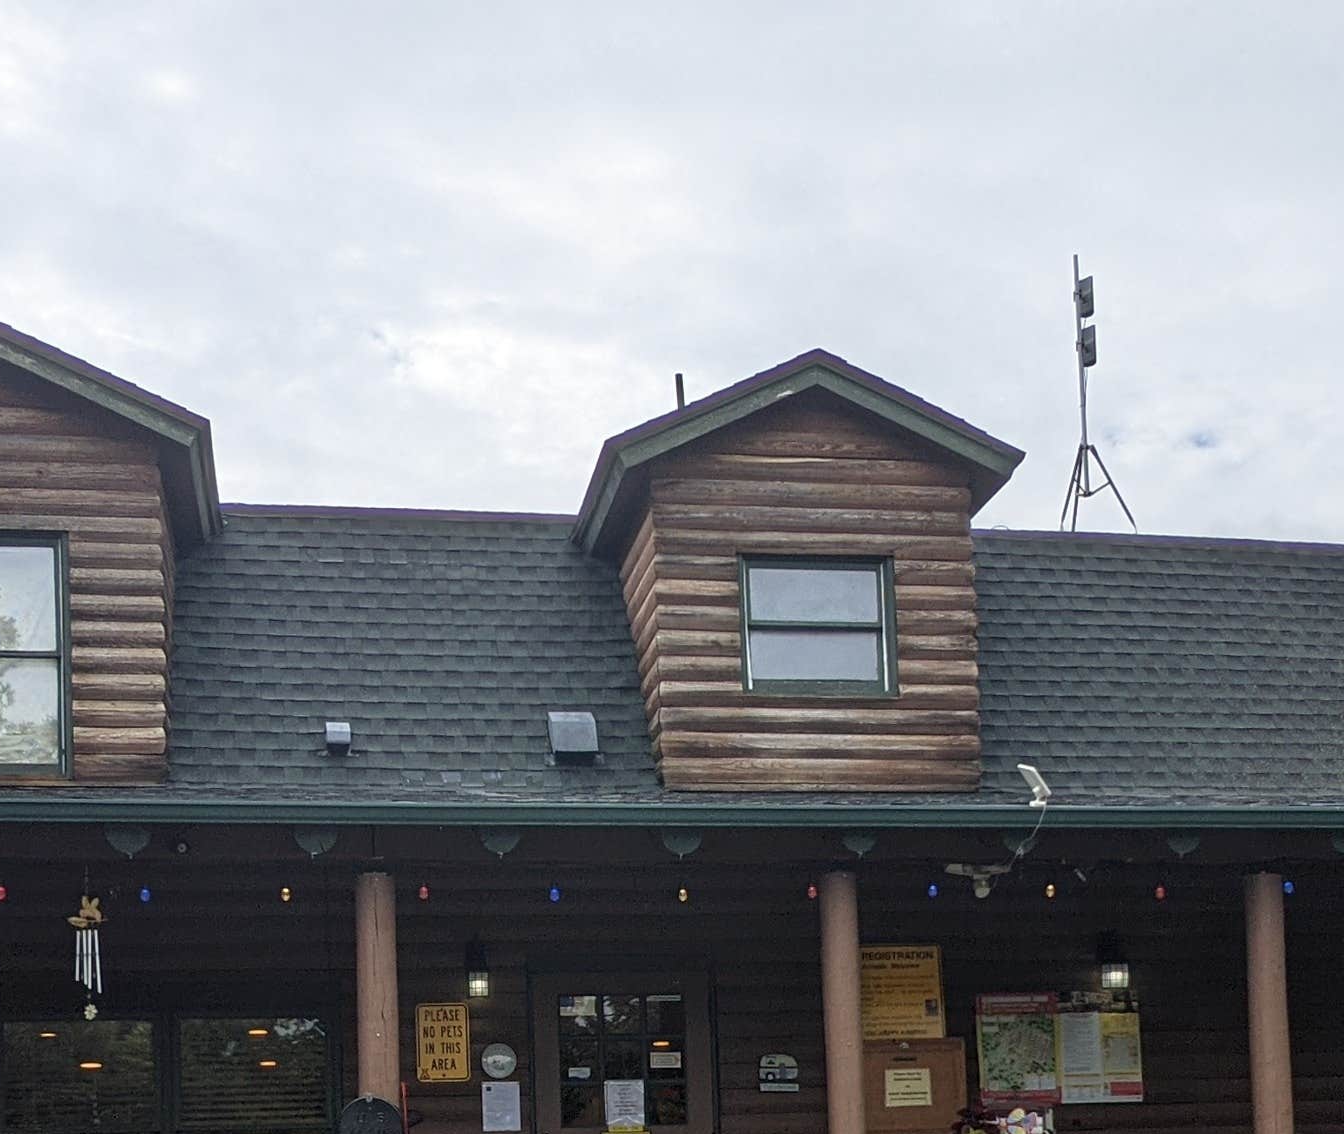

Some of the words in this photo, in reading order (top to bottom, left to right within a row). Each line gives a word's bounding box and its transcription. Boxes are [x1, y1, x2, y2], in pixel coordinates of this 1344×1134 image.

[861, 951, 935, 961] REGISTRATION
[424, 1009, 460, 1021] PLEASE
[423, 1026, 435, 1038] NO
[440, 1025, 463, 1038] PETS
[425, 1042, 435, 1054] IN
[441, 1042, 461, 1054] THIS
[431, 1058, 457, 1070] AREA
